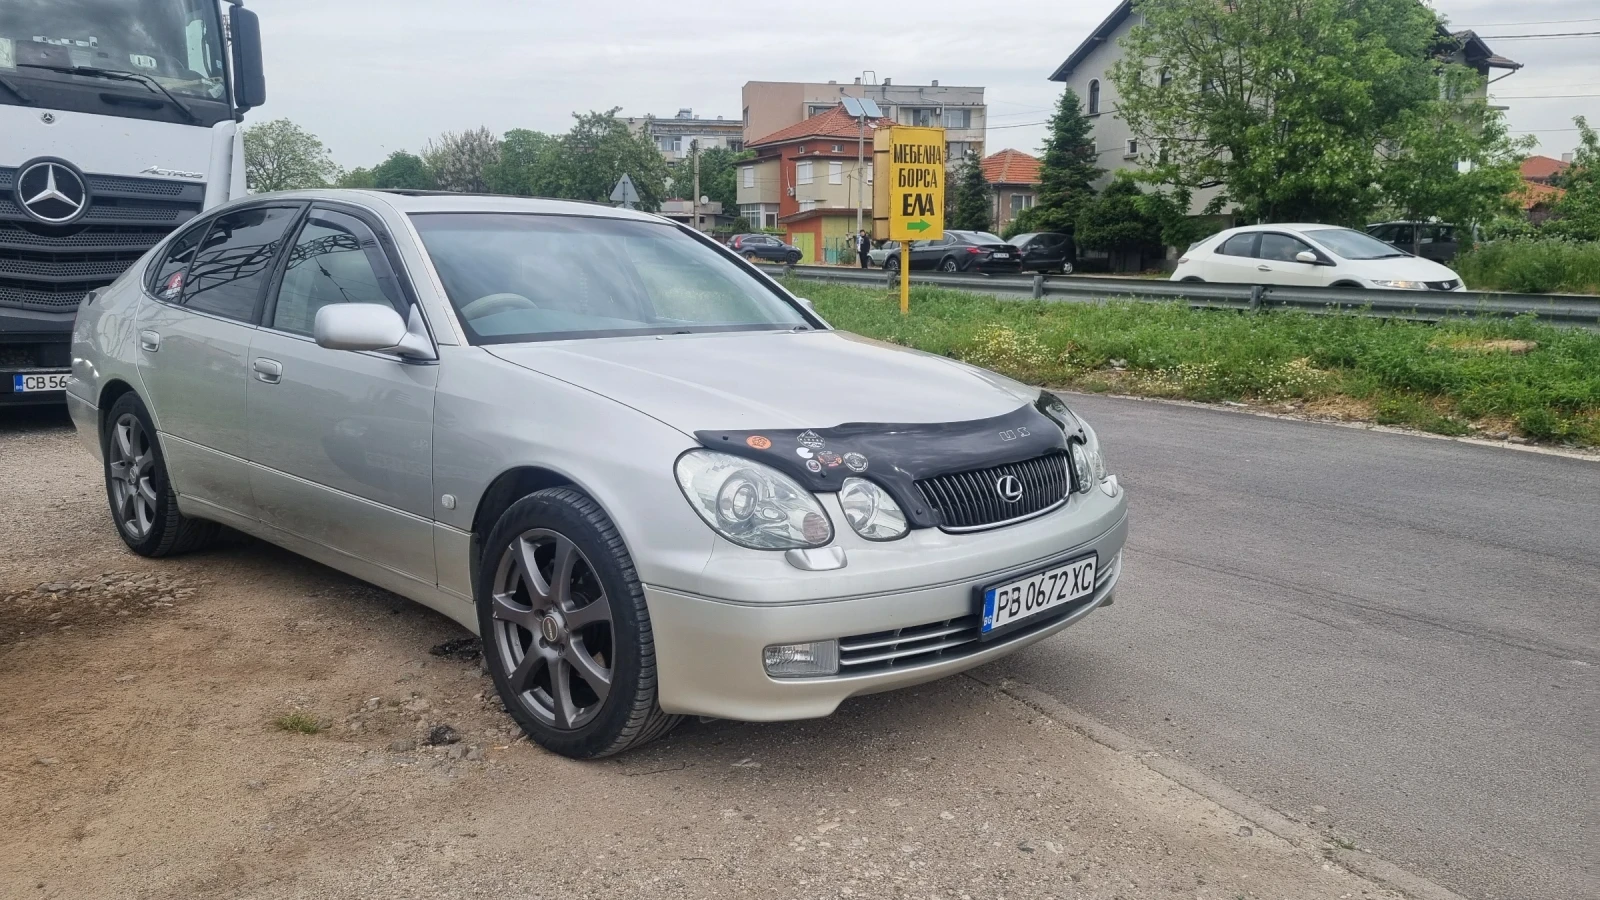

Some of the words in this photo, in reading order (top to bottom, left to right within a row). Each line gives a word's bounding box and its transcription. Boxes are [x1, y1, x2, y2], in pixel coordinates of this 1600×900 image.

[893, 143, 942, 165] МЕБЕЛНА
[898, 167, 938, 188] БОРСА
[902, 193, 935, 217] ЕЛА
[25, 376, 46, 390] CB
[49, 375, 72, 389] 56
[995, 586, 1021, 623] PB
[1025, 570, 1069, 611] 0672
[1069, 562, 1093, 596] XC
